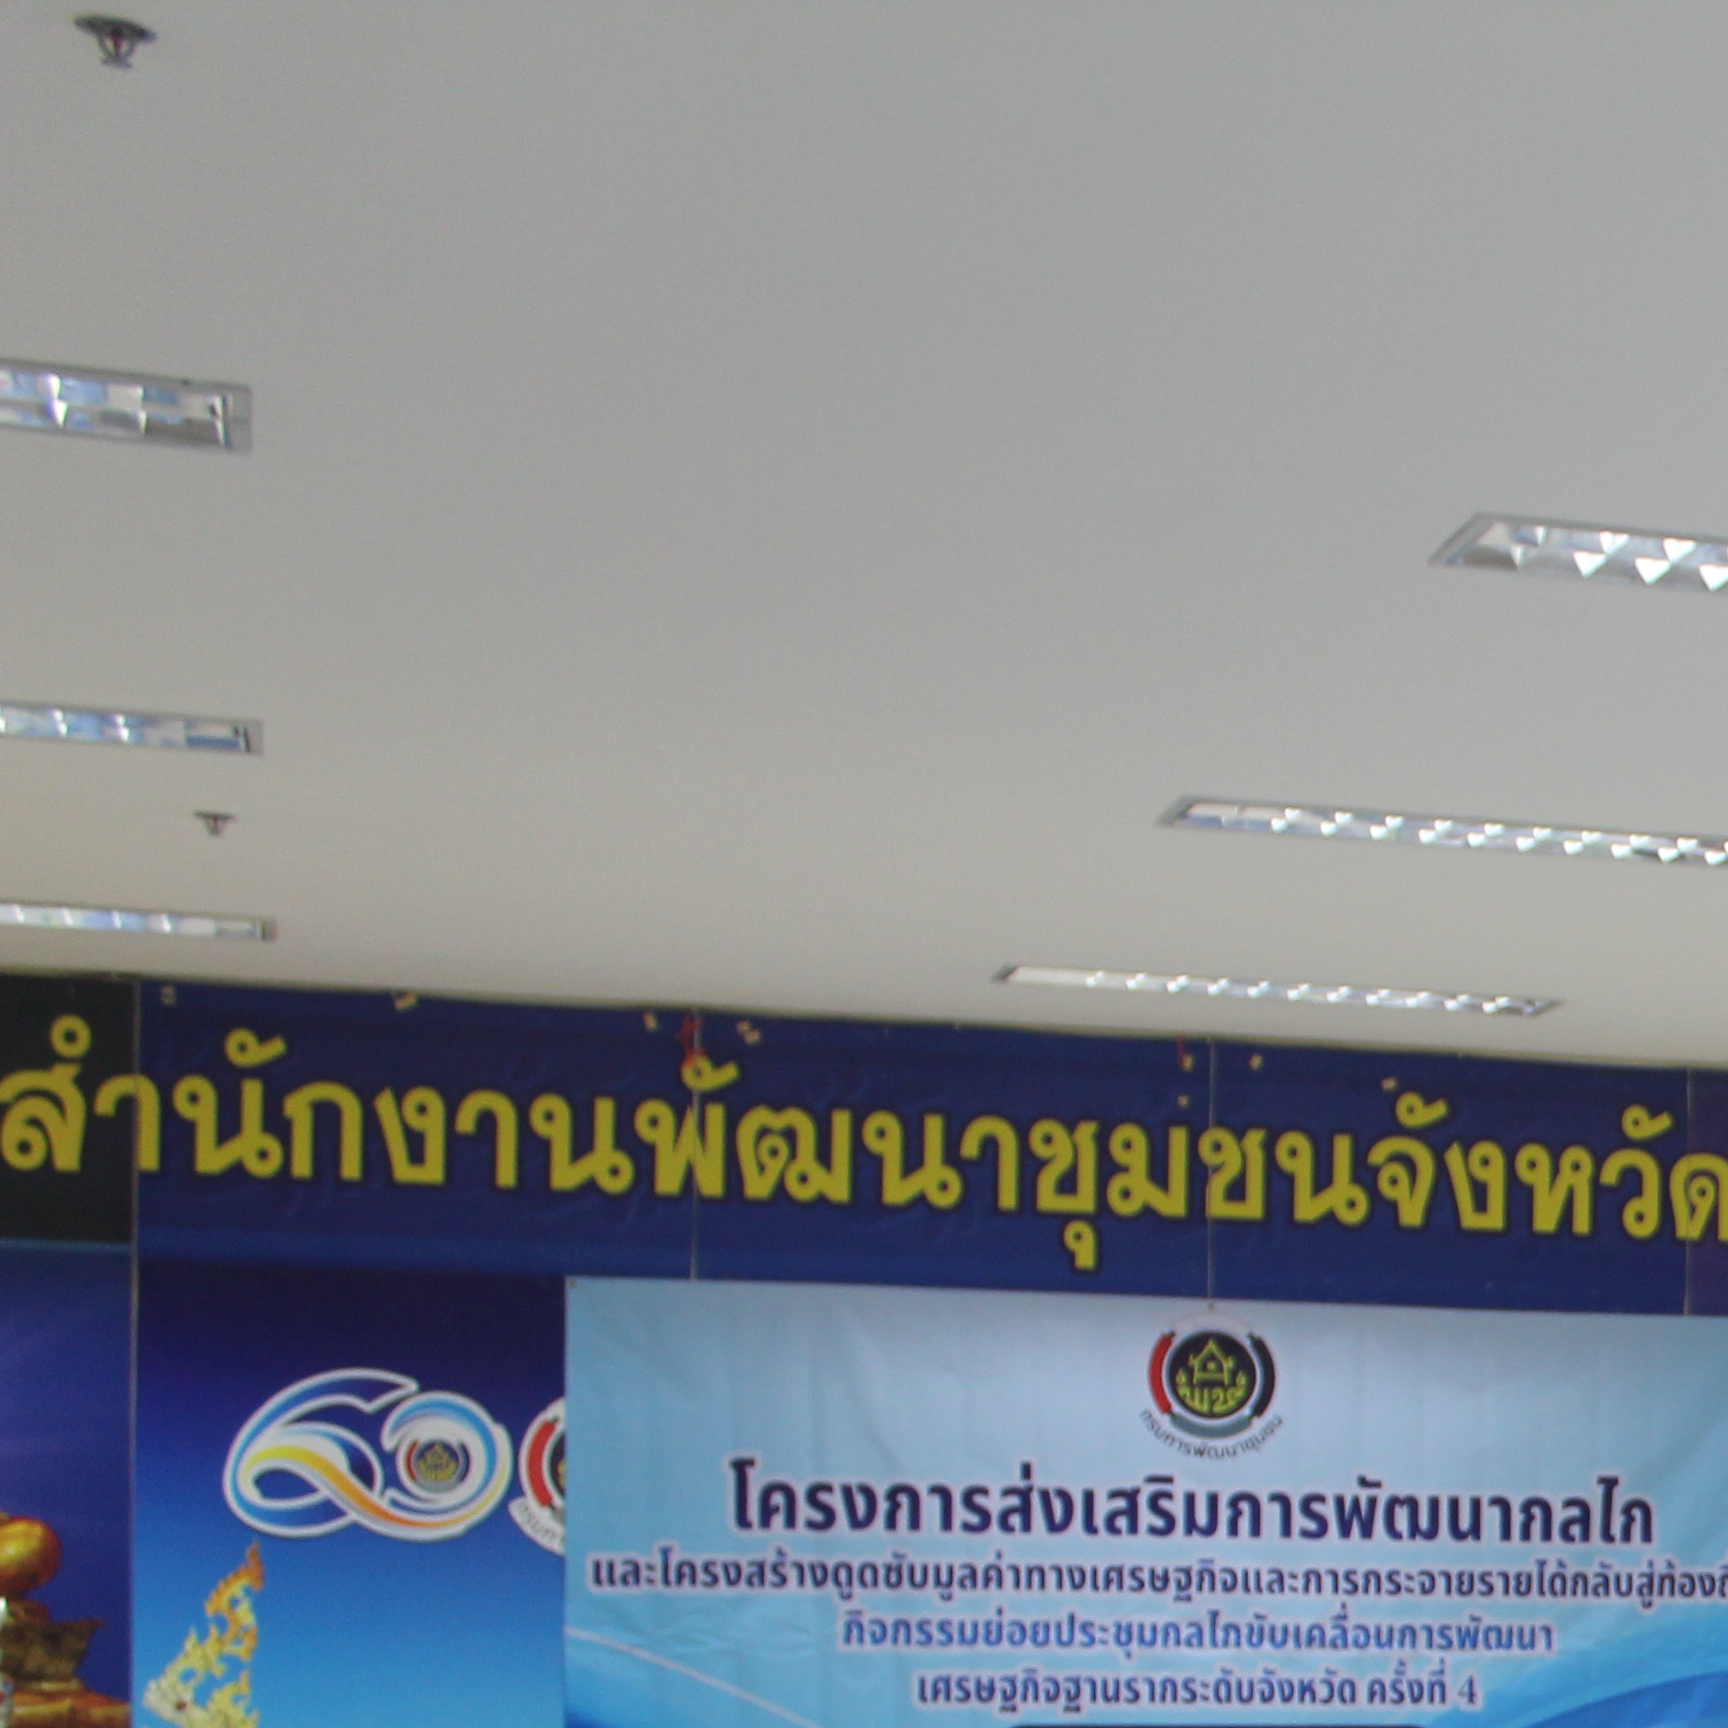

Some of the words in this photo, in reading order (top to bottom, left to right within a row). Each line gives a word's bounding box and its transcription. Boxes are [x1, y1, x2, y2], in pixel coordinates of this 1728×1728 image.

[730, 1458, 1654, 1544] โครงการส่งเสริมการพัฒนากลไก
[842, 1604, 1554, 1659] กิจกรรมย่อยประชุมกลไกขับเคลื่อนการพัฒนา
[917, 1667, 1357, 1713] เศรษฐกิจฐานรากระดับจังหวัด
[1367, 1661, 1447, 1705] ครั้งที่
[1457, 1677, 1478, 1705] 4
